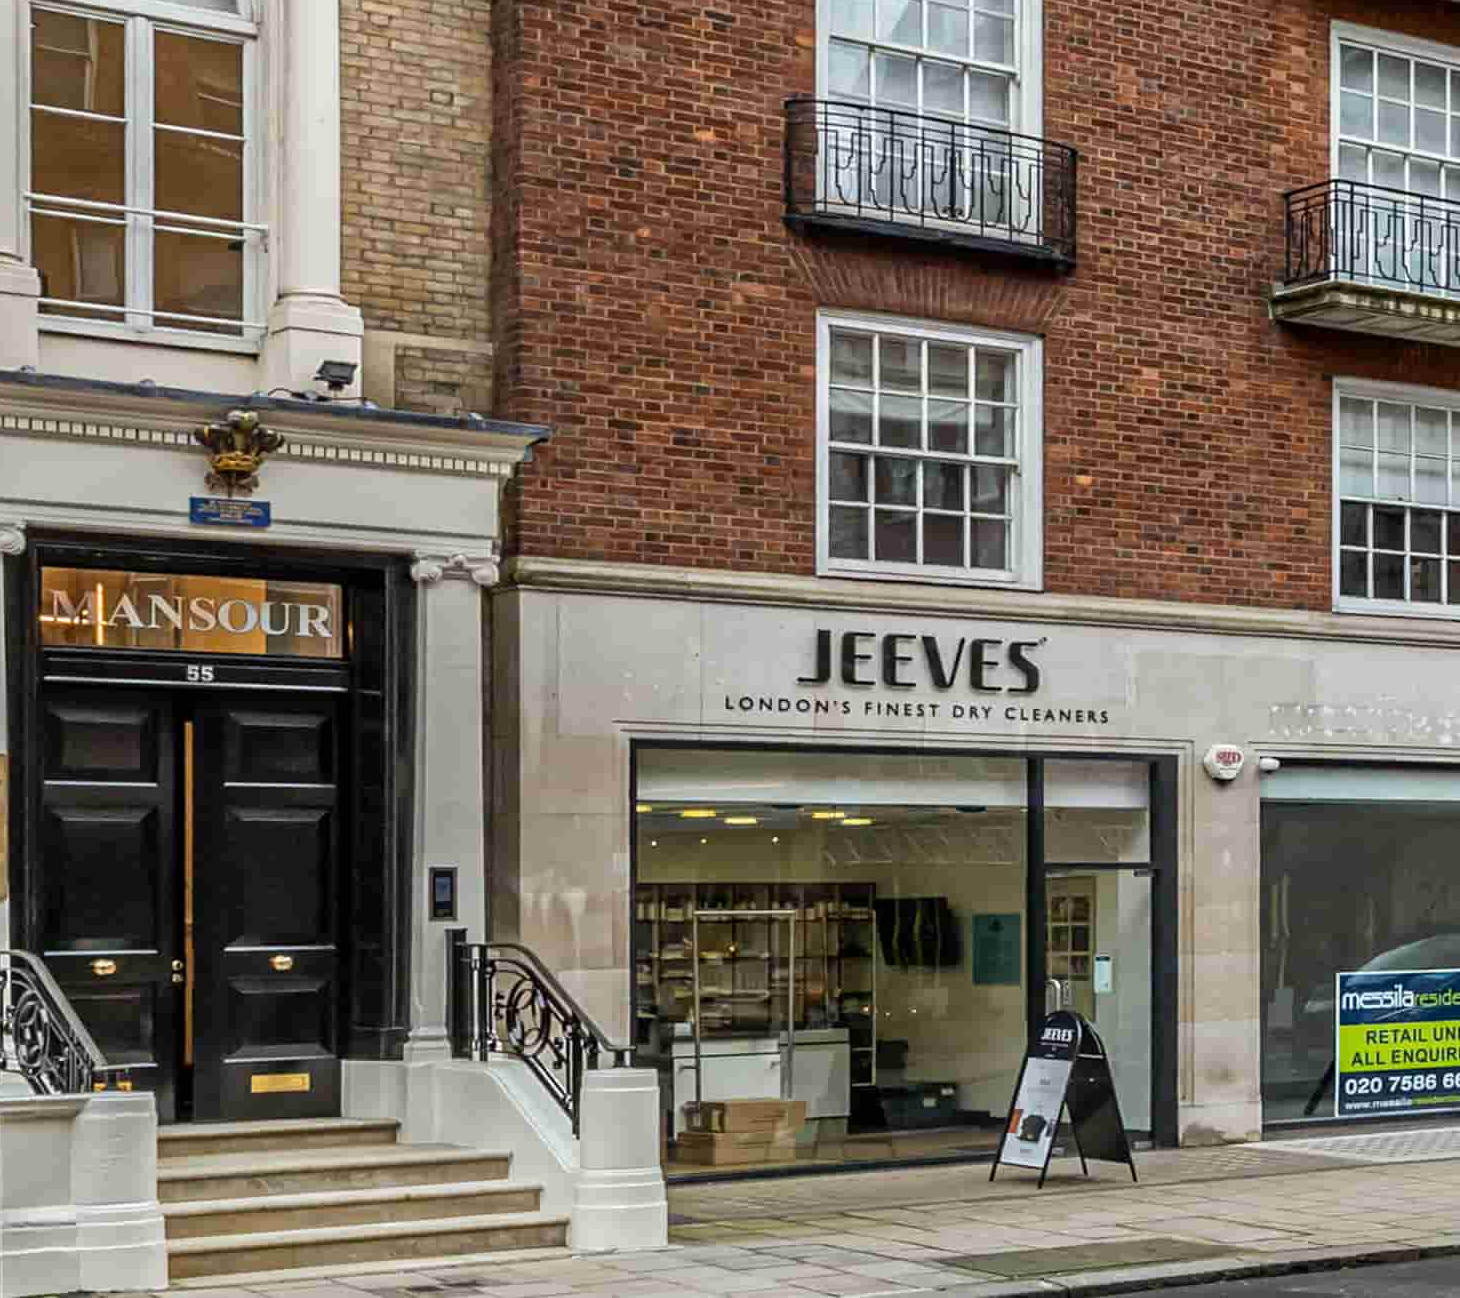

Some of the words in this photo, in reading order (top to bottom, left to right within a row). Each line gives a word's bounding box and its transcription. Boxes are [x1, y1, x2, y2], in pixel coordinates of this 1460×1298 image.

[51, 590, 333, 638] MANSOUR
[796, 628, 1040, 694] JEEVES
[186, 664, 215, 683] 55
[724, 696, 852, 715] LONDON'S
[863, 702, 940, 718] FINEST
[952, 705, 993, 721] DRY
[1004, 706, 1110, 724] CLEANERS
[1365, 1028, 1428, 1045] RETAIL
[1351, 1052, 1386, 1067] ALL
[1344, 1077, 1383, 1095] 020
[1388, 1073, 1438, 1092] 7586
